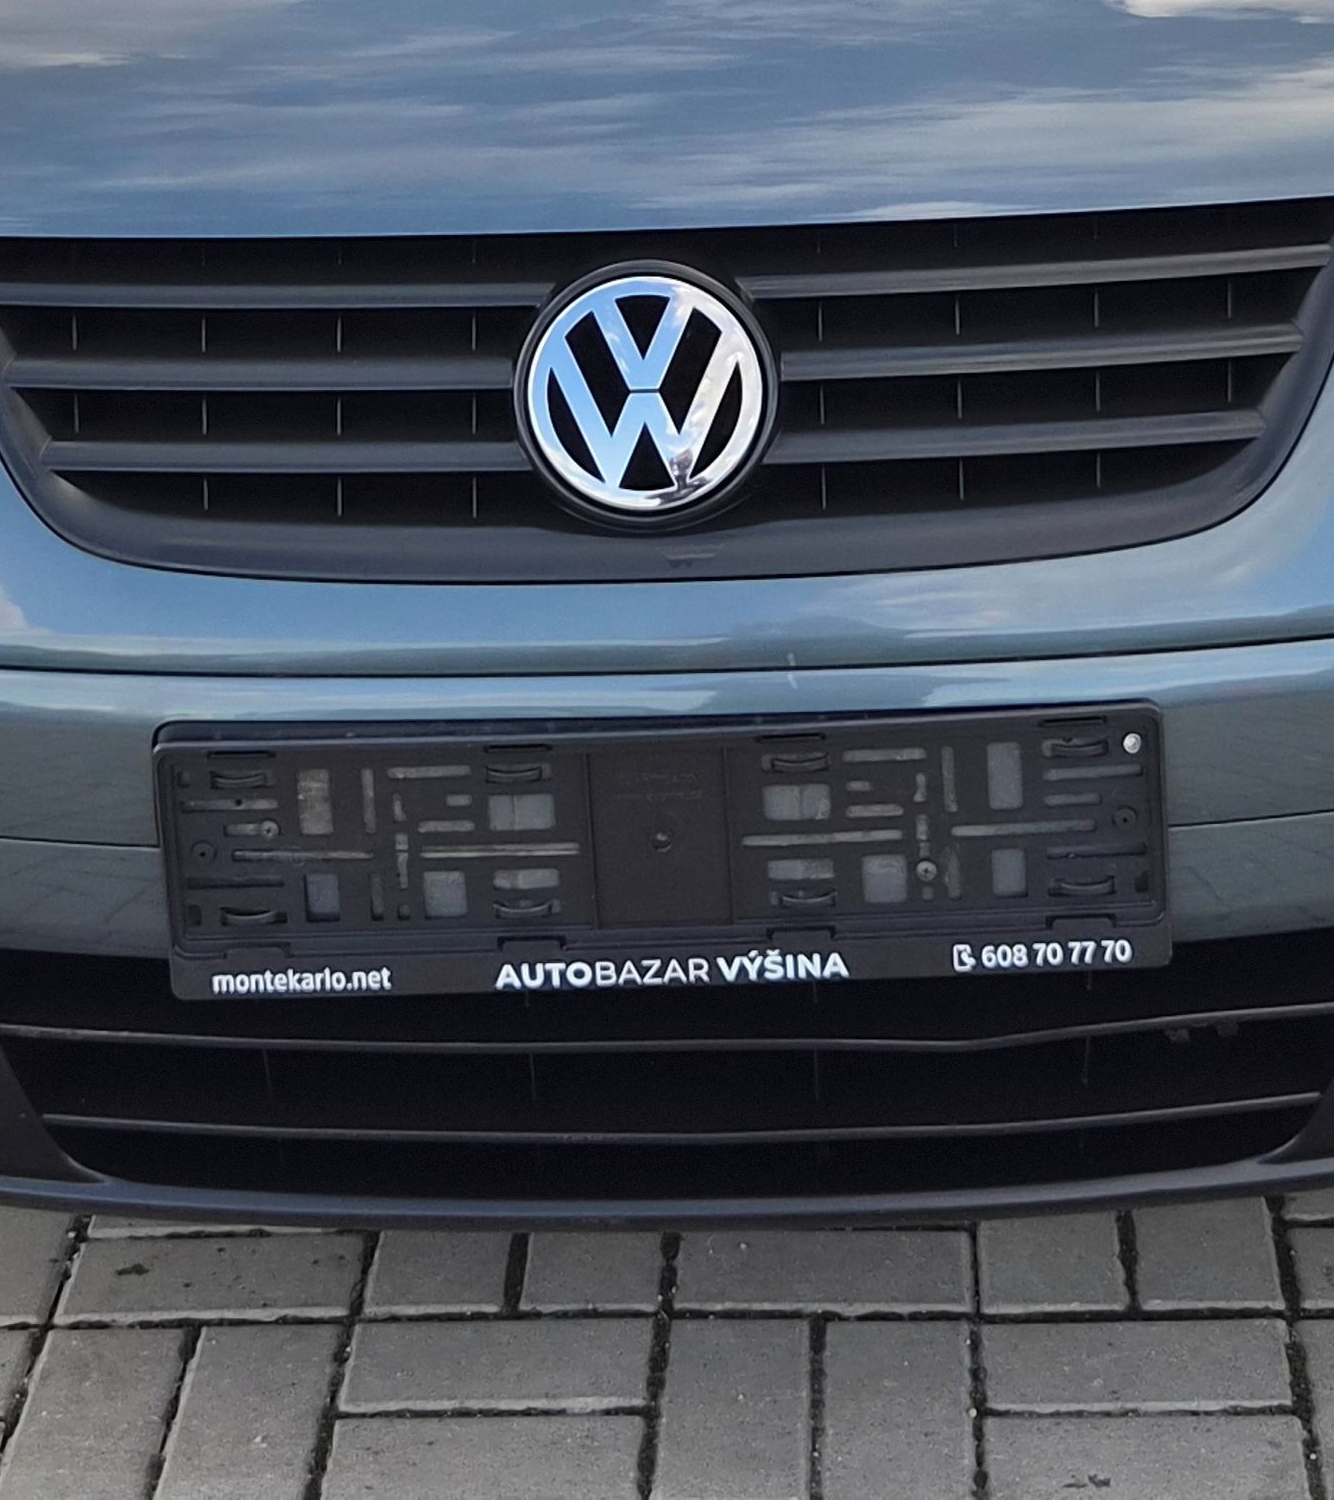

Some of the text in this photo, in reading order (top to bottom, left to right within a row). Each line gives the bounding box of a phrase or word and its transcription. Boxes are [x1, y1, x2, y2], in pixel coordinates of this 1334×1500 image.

[528, 276, 763, 510] VW
[495, 948, 851, 990] AUTOBAZAR VÝŠINA
[981, 939, 1132, 969] 608 70 77 70
[211, 966, 393, 995] montekarlo.net
